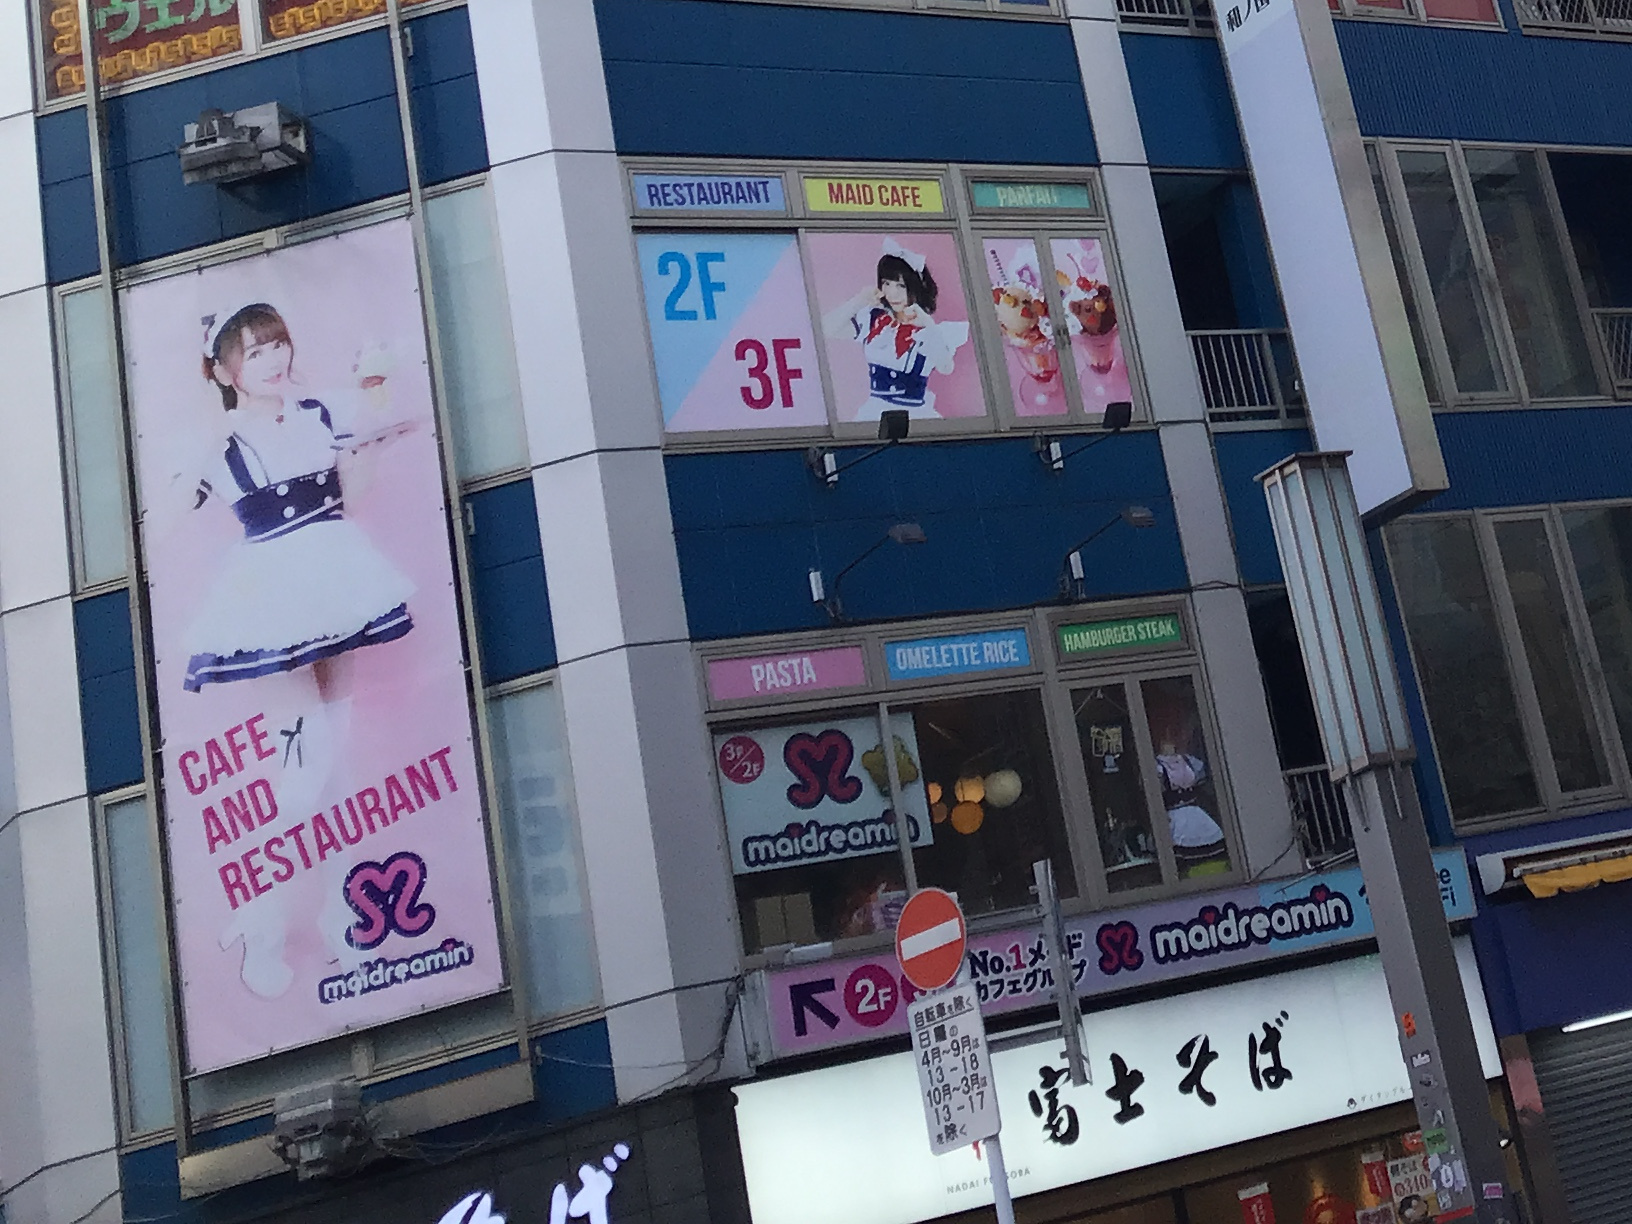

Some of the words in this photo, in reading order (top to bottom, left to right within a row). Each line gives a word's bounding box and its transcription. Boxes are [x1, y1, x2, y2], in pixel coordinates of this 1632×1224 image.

[647, 180, 770, 208] RESTAURANT
[828, 181, 875, 208] MAID
[878, 184, 923, 209] CAFE
[657, 251, 726, 321] 2F
[734, 337, 804, 410] 3F
[895, 642, 981, 671] OMELETTE
[984, 639, 1020, 664] RICE
[1063, 628, 1135, 652] HAMBURGER
[1137, 619, 1175, 643] STEAK
[751, 657, 817, 692] PASTA
[177, 712, 278, 798] CAFE
[201, 792, 280, 854] AND
[217, 746, 462, 910] RESTAURANT
[743, 810, 921, 868] maidreami
[1153, 887, 1354, 964] maidreamin
[319, 941, 474, 1005] maidreamin
[855, 978, 892, 1014] 2F
[976, 959, 1087, 1003] カフェグルプ
[1028, 1009, 1295, 1148] 富士そば
[935, 1123, 968, 1146] を除く
